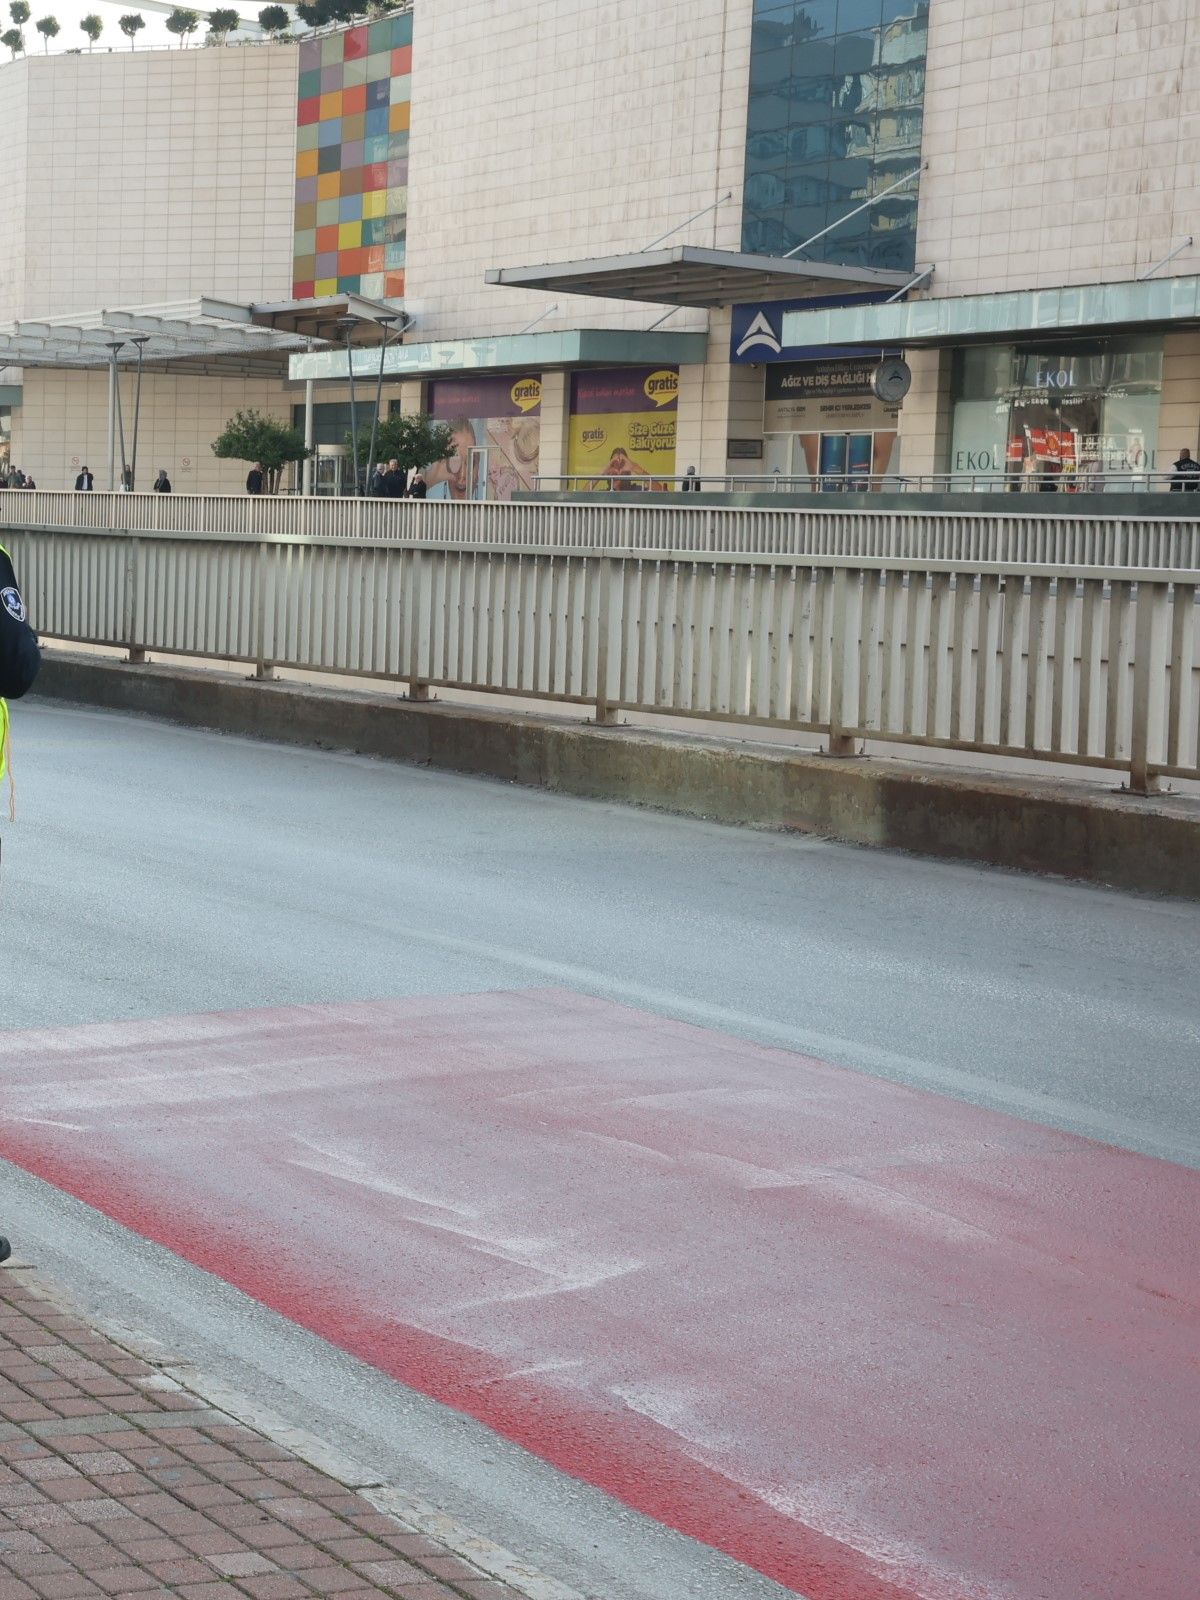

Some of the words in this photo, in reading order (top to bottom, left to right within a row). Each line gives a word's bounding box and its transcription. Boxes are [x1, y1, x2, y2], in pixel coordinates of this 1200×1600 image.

[648, 374, 678, 395] gratis
[803, 376, 814, 386] VE
[1035, 370, 1077, 388] EKOL
[514, 382, 540, 400] gratis
[582, 429, 604, 443] gratis
[629, 422, 649, 437] Size
[957, 450, 1000, 471] EKOL
